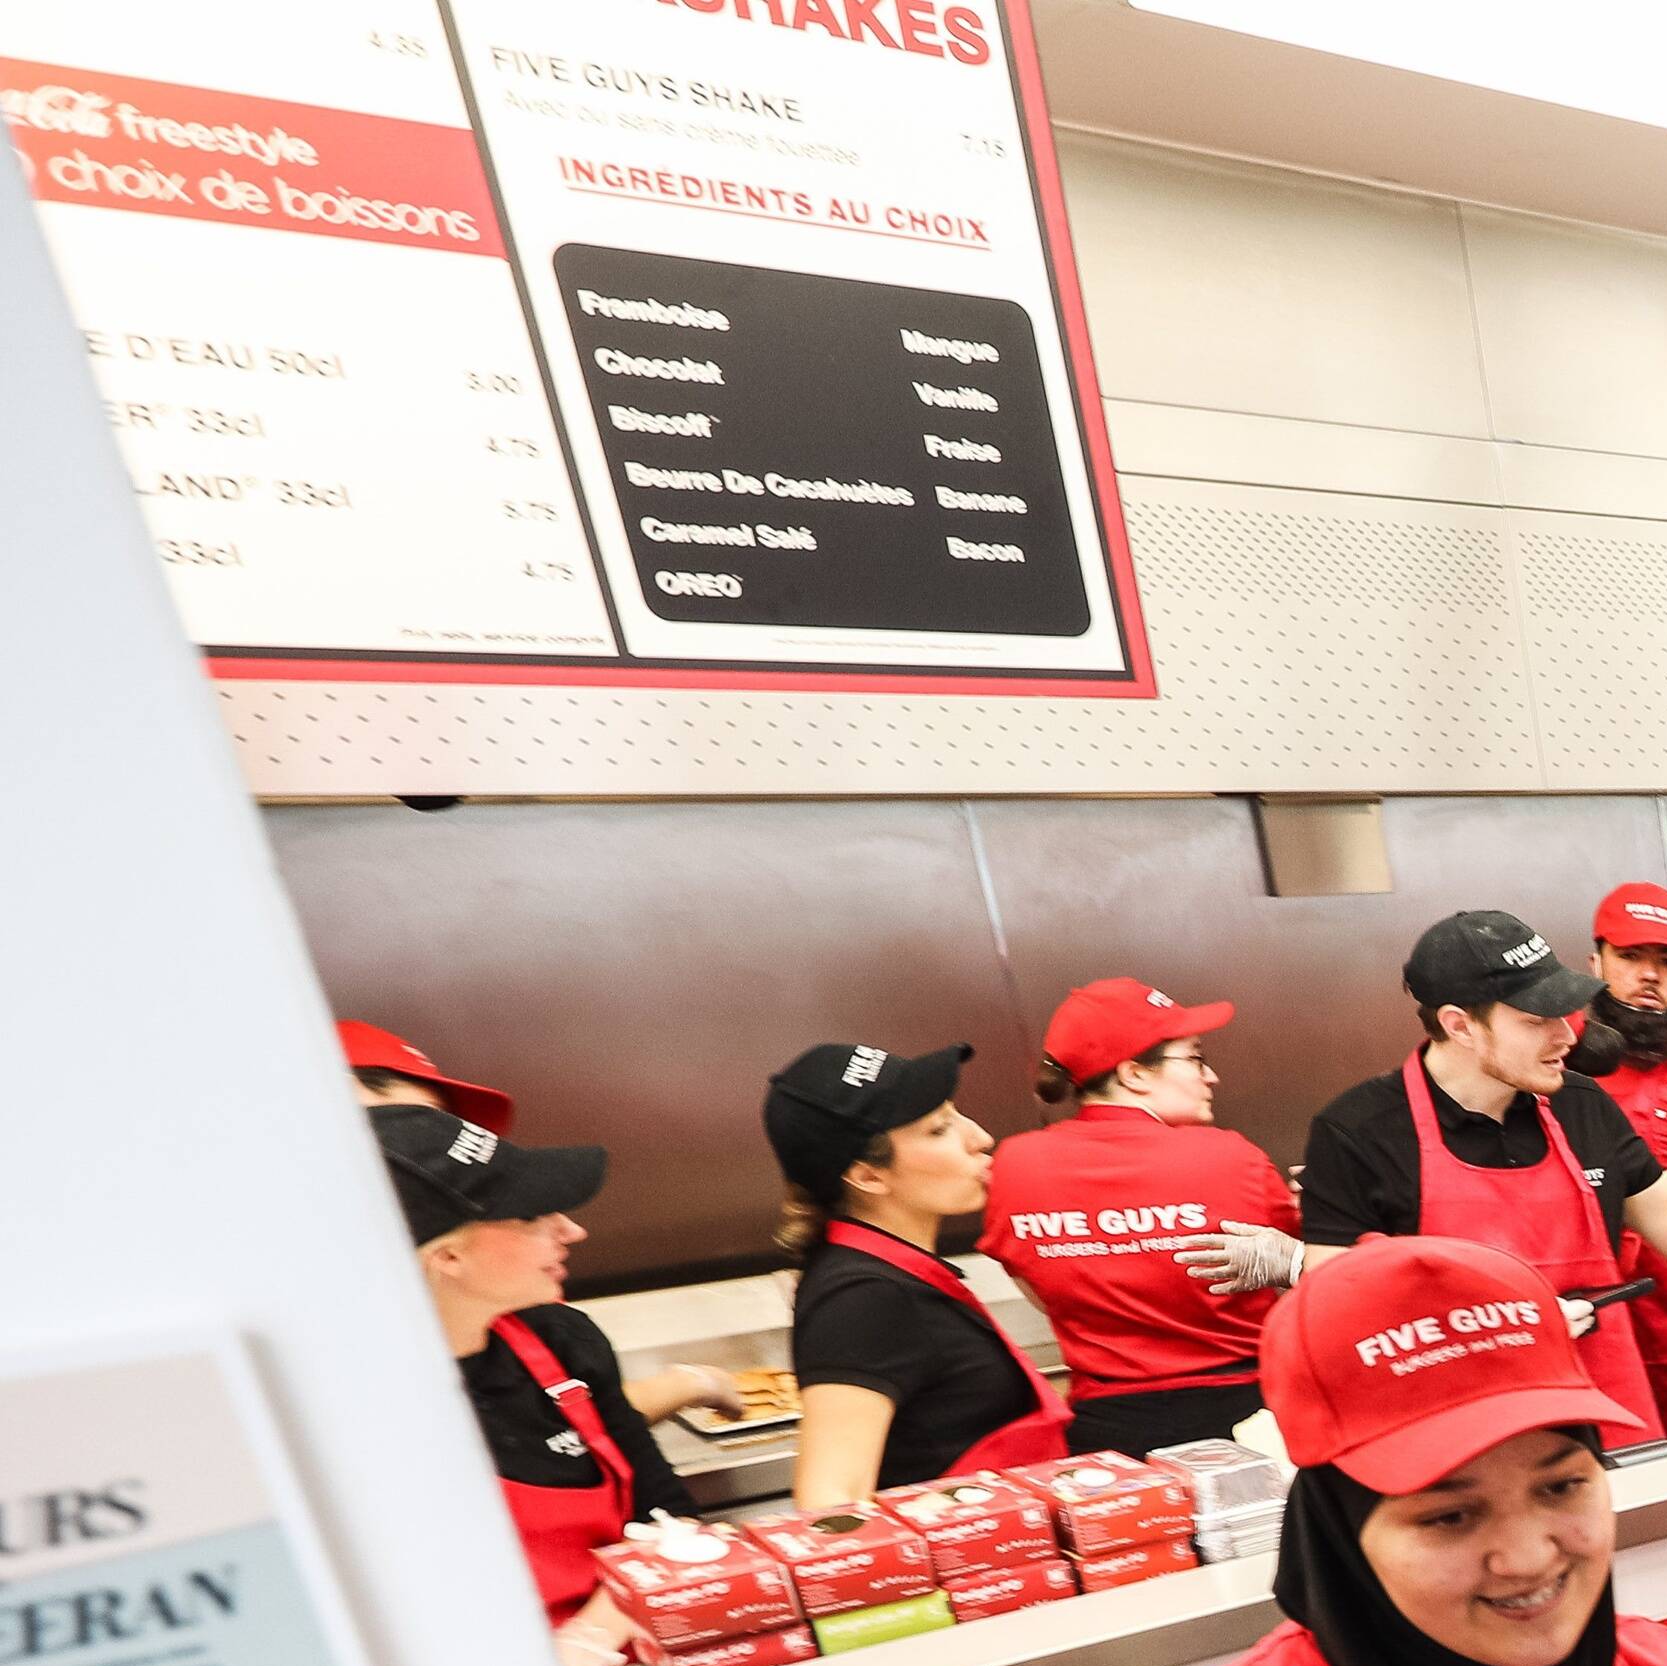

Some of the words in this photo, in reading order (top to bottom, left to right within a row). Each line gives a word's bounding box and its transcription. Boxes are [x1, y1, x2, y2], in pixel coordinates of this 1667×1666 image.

[489, 45, 569, 83] FIVE
[583, 62, 681, 102] GUYS
[689, 81, 804, 123] SHAKE
[113, 103, 320, 167] freestyle
[47, 148, 195, 205] choix
[199, 168, 272, 215] de
[273, 176, 480, 242] boissons
[829, 198, 871, 226] AU
[886, 206, 991, 243] CHOIX
[577, 288, 731, 333] Framboise
[899, 328, 1000, 363] Mangue
[594, 346, 726, 386] Chocolat
[911, 381, 1000, 413] Vanille
[922, 432, 1003, 464] Fraise
[623, 460, 723, 494] Beurre
[721, 468, 766, 497] De
[934, 486, 1028, 516] Banane
[640, 516, 758, 548] Caramel
[944, 536, 1026, 564] Bacon
[1010, 1210, 1092, 1240] FIVE
[1096, 1202, 1208, 1236] GUYS
[1354, 1315, 1448, 1368] FIVE
[1447, 1299, 1542, 1334] GUYS
